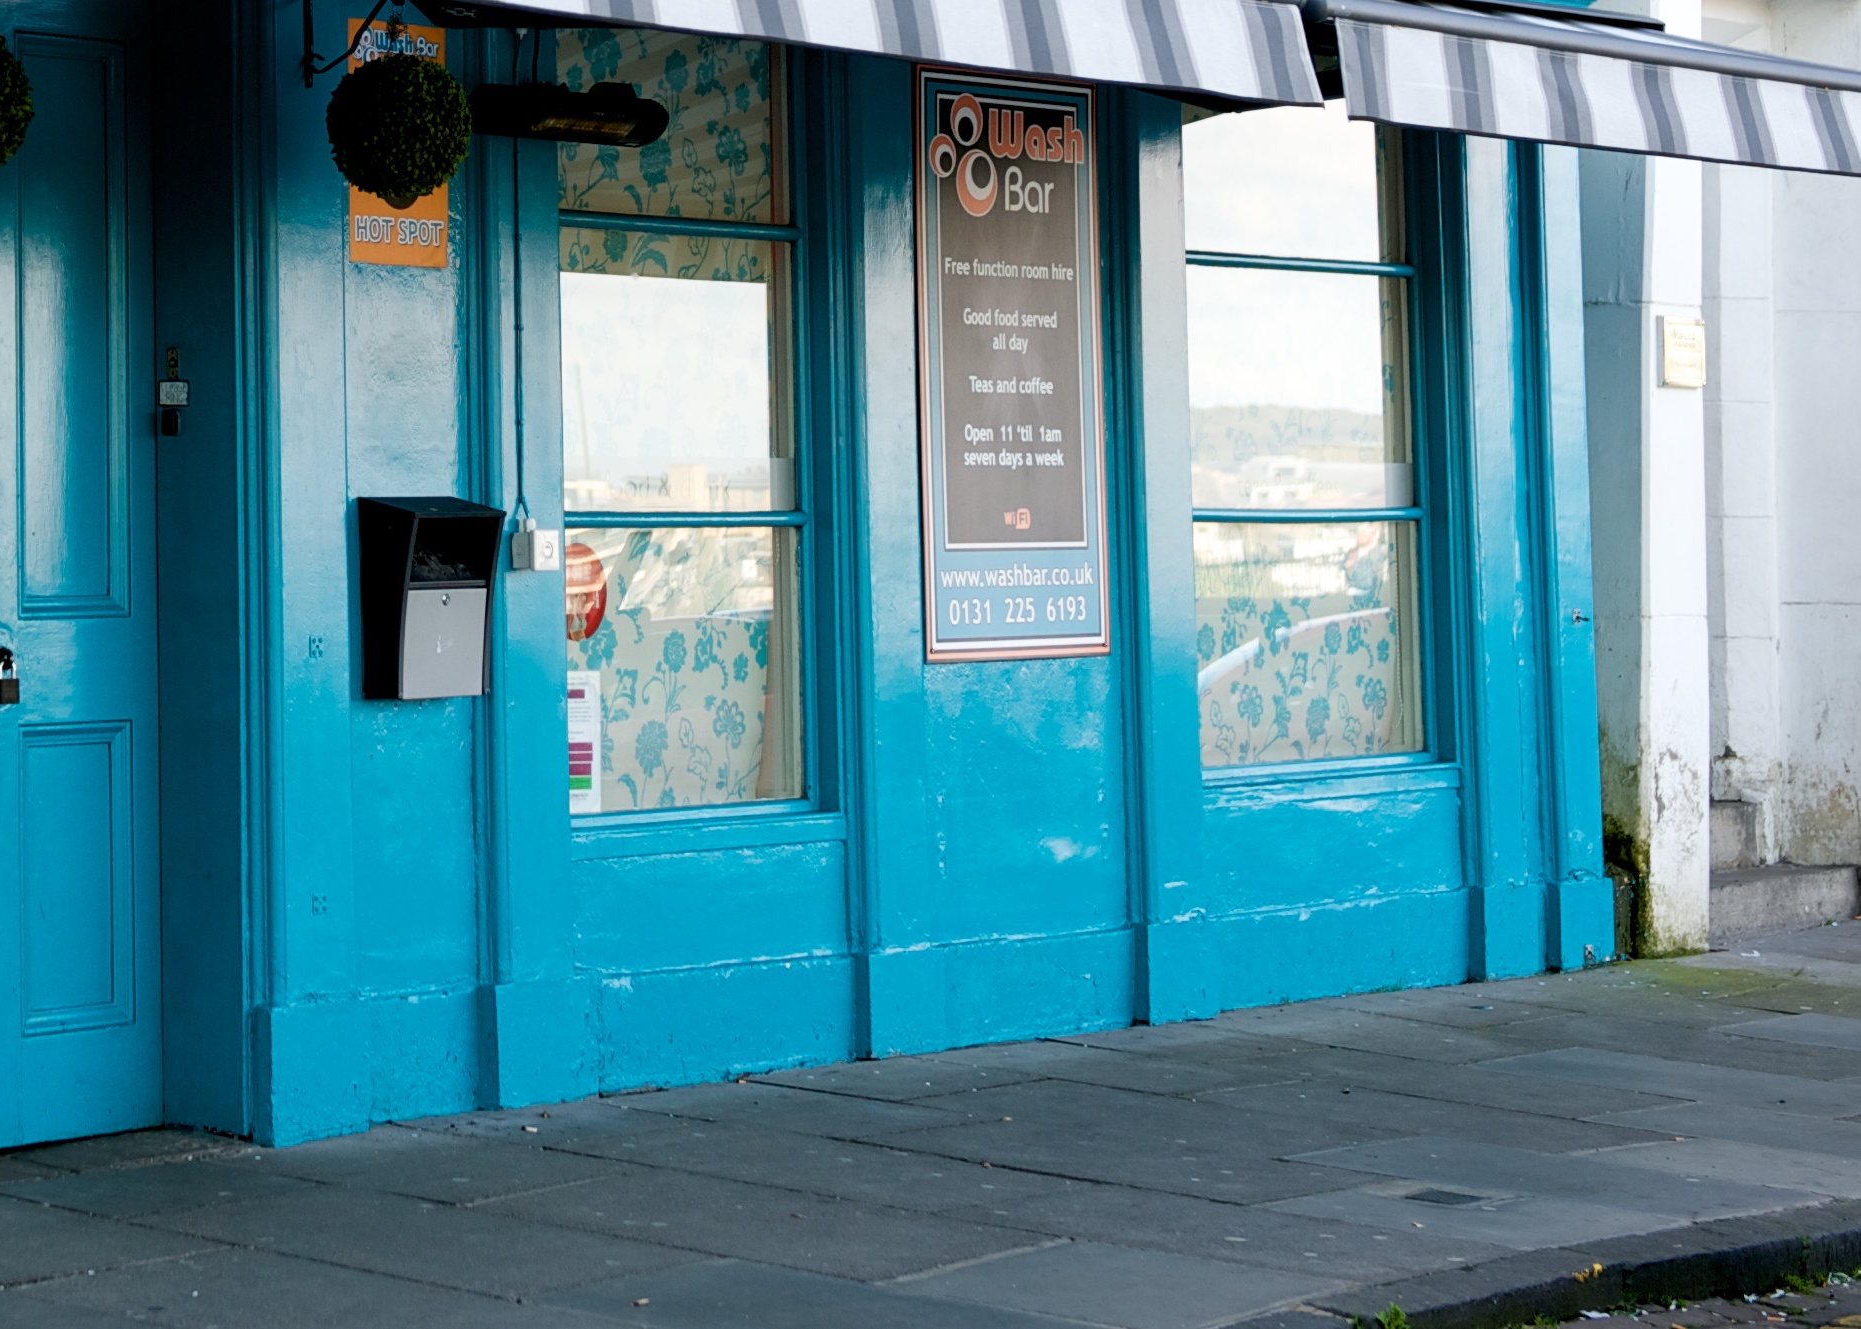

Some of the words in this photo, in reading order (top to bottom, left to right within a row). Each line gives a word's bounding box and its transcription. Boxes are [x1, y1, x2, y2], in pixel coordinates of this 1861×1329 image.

[415, 36, 440, 59] Bar
[988, 107, 1085, 165] Wash
[1004, 165, 1055, 214] Bar
[354, 214, 395, 244] HOT
[397, 219, 445, 247] SPOT
[944, 257, 971, 277] Free
[973, 258, 1019, 279] function
[1021, 263, 1050, 280] room
[1051, 263, 1075, 281] hire
[963, 307, 992, 327] Good
[994, 308, 1019, 328] food
[1021, 311, 1058, 329] served
[992, 333, 1007, 351] all
[1008, 334, 1029, 355] day
[968, 375, 994, 394] Teas
[996, 377, 1017, 394] and
[1018, 377, 1054, 395] coffee
[964, 424, 994, 446] Open
[1000, 425, 1014, 442] 11
[1039, 425, 1063, 443] 1am
[963, 451, 997, 467] seven
[998, 450, 1024, 471] days
[1025, 453, 1033, 467] a
[1034, 450, 1065, 467] week
[941, 562, 1094, 589] www.washbar.co.uk
[948, 598, 992, 626] 0131
[1004, 597, 1036, 623] 225
[1046, 595, 1087, 622] 6193
